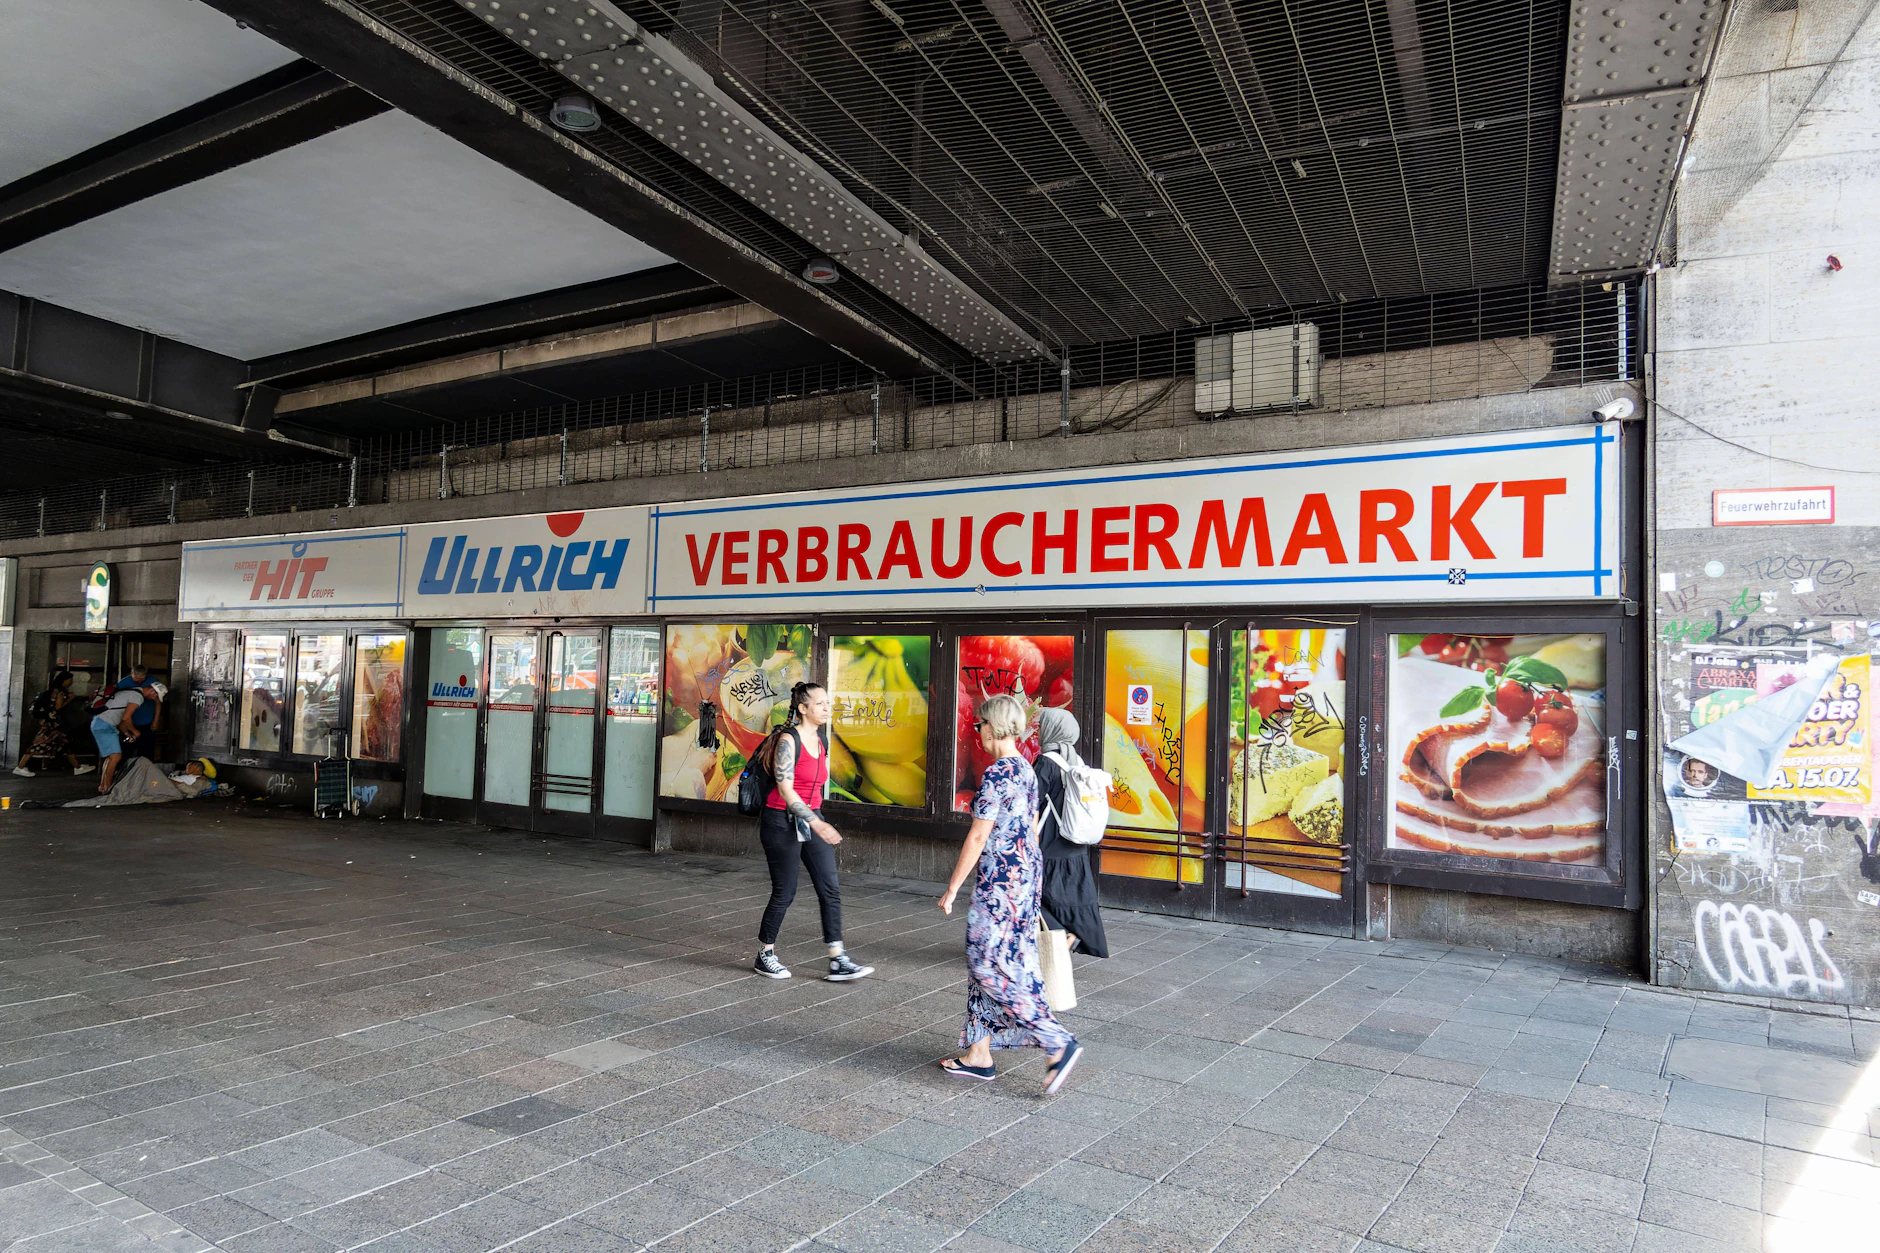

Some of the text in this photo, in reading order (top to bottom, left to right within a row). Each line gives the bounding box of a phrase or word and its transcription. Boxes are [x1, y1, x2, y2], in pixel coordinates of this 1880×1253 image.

[1720, 498, 1827, 513] Feuerwehrzufahrt
[686, 477, 1567, 586] VERBRAUCHERMARKT
[234, 561, 259, 571] PARTNER
[417, 535, 631, 596] ULLRICH
[242, 573, 255, 582] DER
[250, 556, 329, 601] HIT
[311, 588, 336, 599] GRUPPE
[1698, 668, 1757, 683] ABRAXA
[432, 682, 475, 698] ULLRICH
[1843, 683, 1861, 699] &
[1796, 767, 1861, 789] 15.07.
